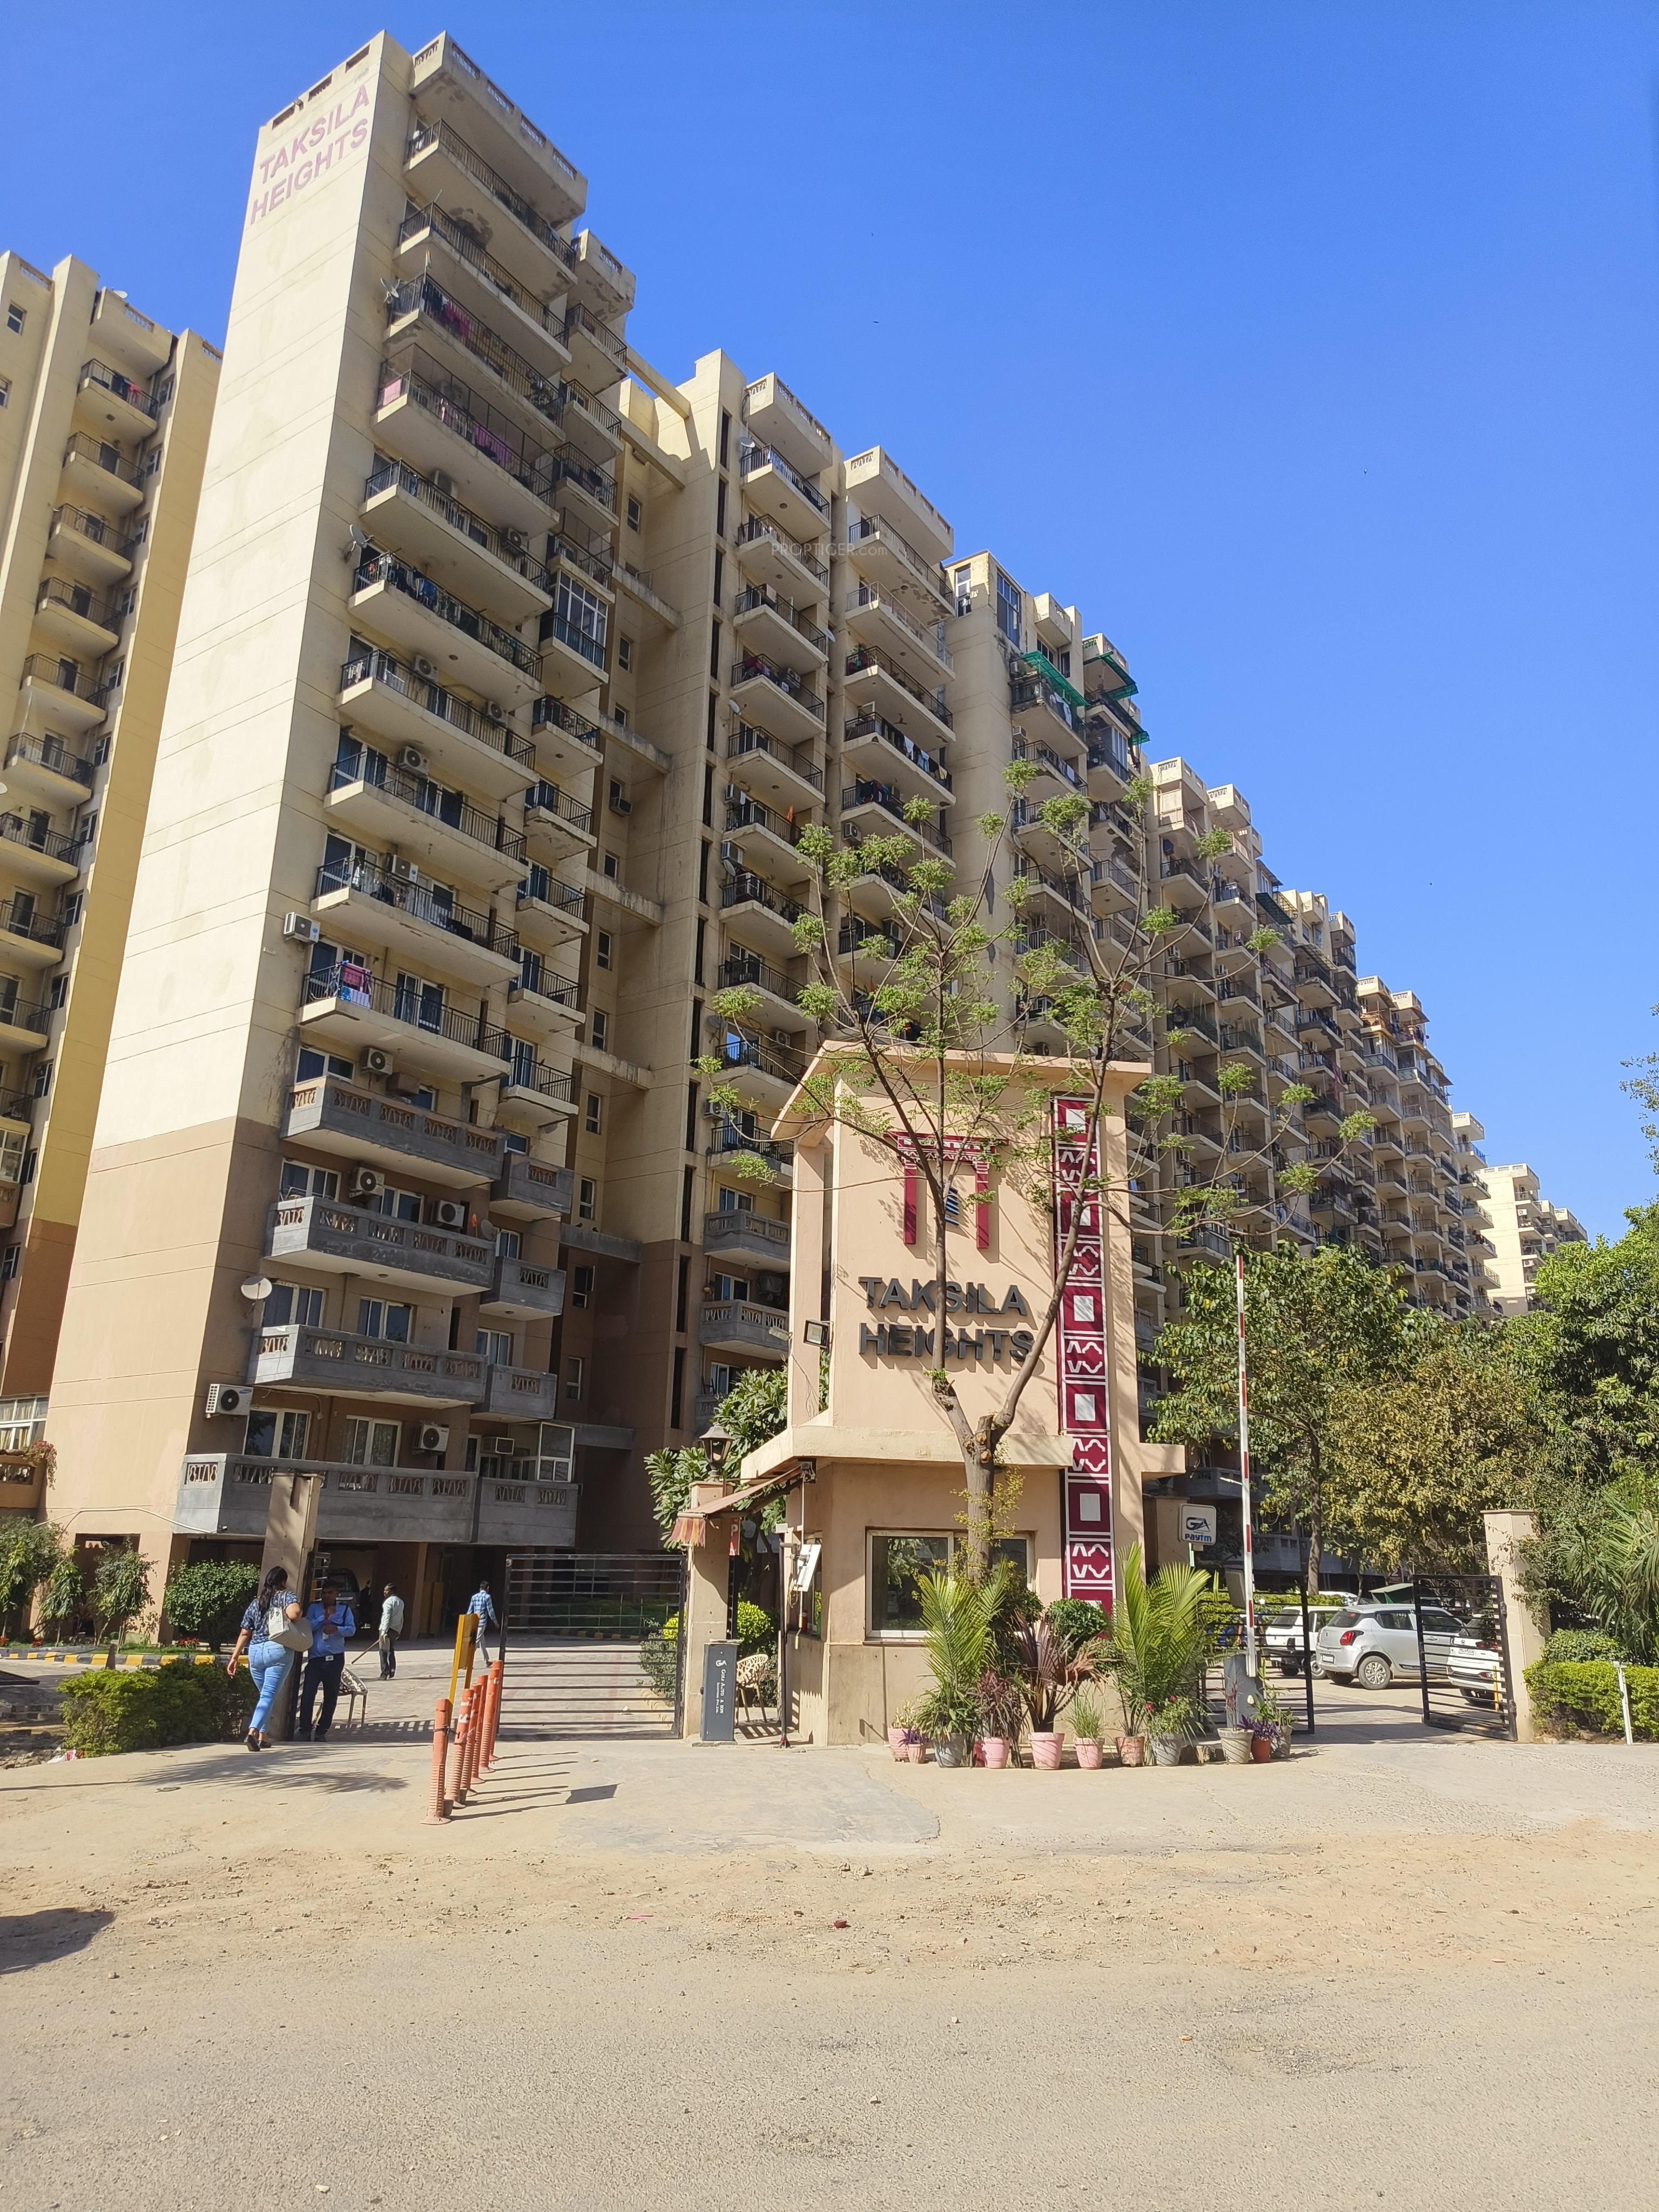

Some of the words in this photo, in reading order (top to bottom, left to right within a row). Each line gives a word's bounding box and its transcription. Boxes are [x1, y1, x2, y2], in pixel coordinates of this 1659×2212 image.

[260, 84, 370, 184] TAKSILA
[249, 118, 368, 226] HEIGHTS
[858, 1276, 1027, 1316] TAKSILA
[858, 1322, 1035, 1361] HEIGHTS
